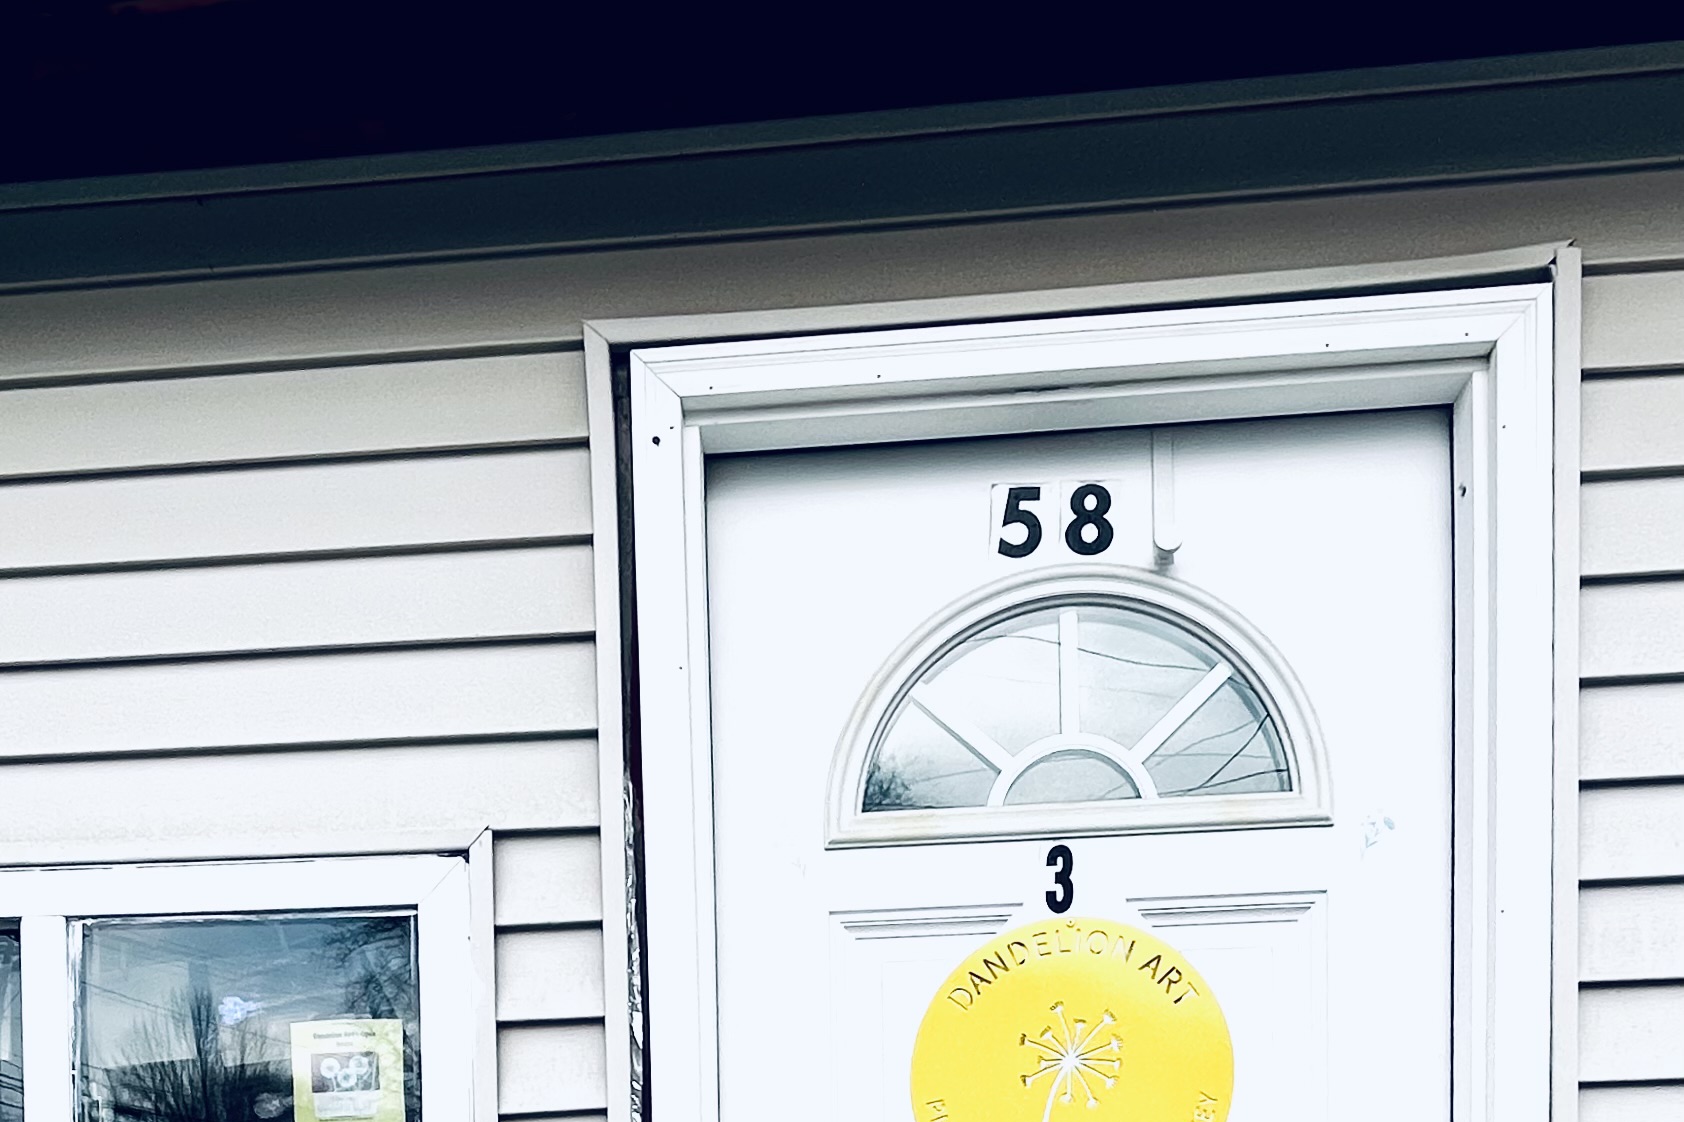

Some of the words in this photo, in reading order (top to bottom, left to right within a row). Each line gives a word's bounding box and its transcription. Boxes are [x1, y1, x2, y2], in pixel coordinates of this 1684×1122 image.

[998, 484, 1114, 558] 58
[1045, 844, 1074, 914] 3
[947, 928, 1136, 1011] DANDELION
[1138, 954, 1200, 1005] ART
